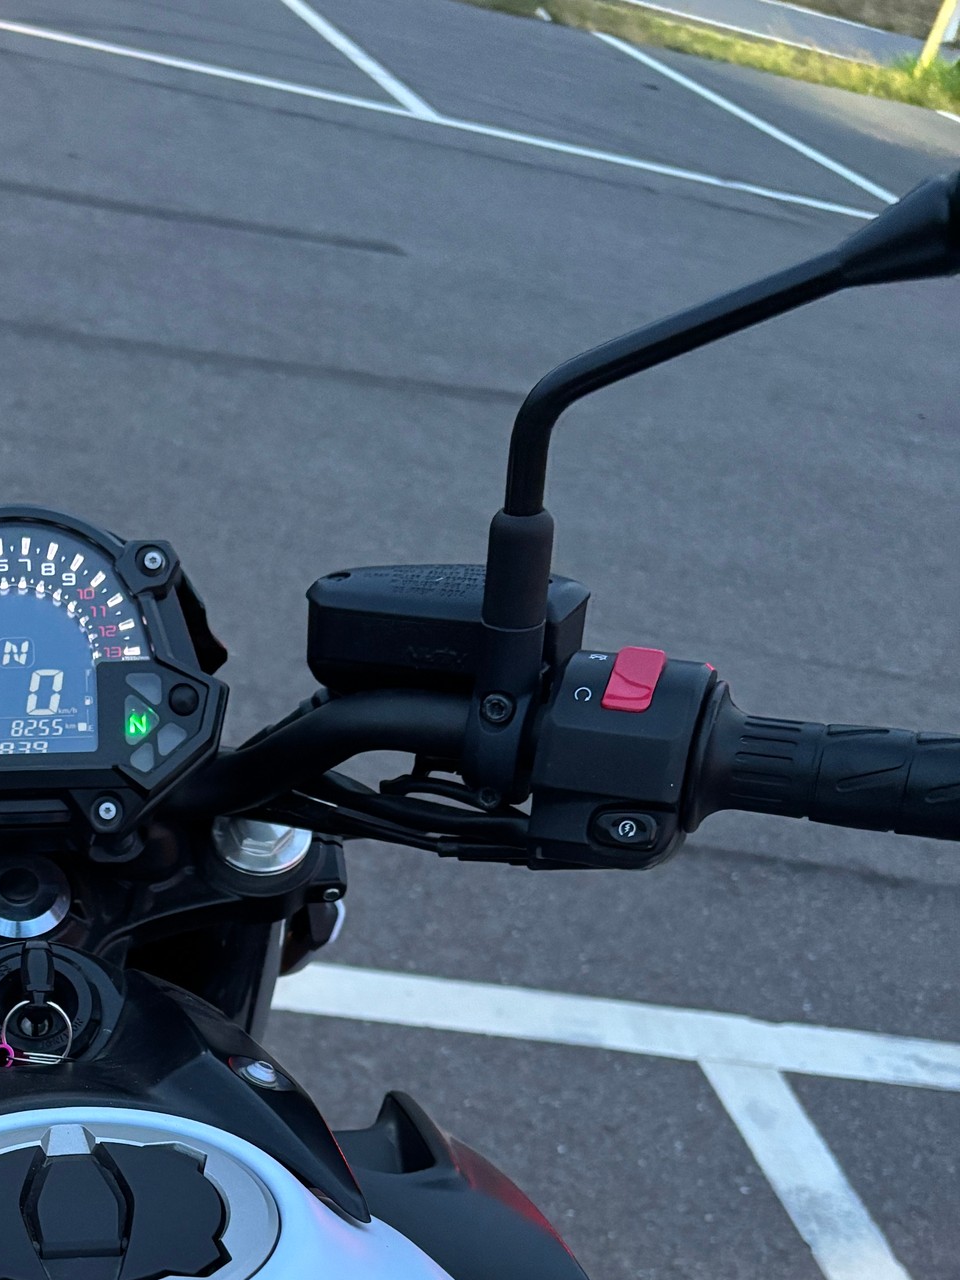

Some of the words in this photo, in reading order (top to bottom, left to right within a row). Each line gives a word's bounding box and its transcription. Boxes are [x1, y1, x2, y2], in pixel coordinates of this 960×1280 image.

[18, 558, 32, 572] 7
[41, 562, 56, 576] 8
[62, 573, 77, 586] 9
[76, 587, 95, 600] 10
[90, 605, 107, 618] 11
[98, 625, 117, 638] 12
[2, 640, 29, 666] N
[104, 647, 122, 658] 13
[26, 669, 64, 716] 0
[10, 718, 64, 737] 8255
[129, 714, 147, 734] N
